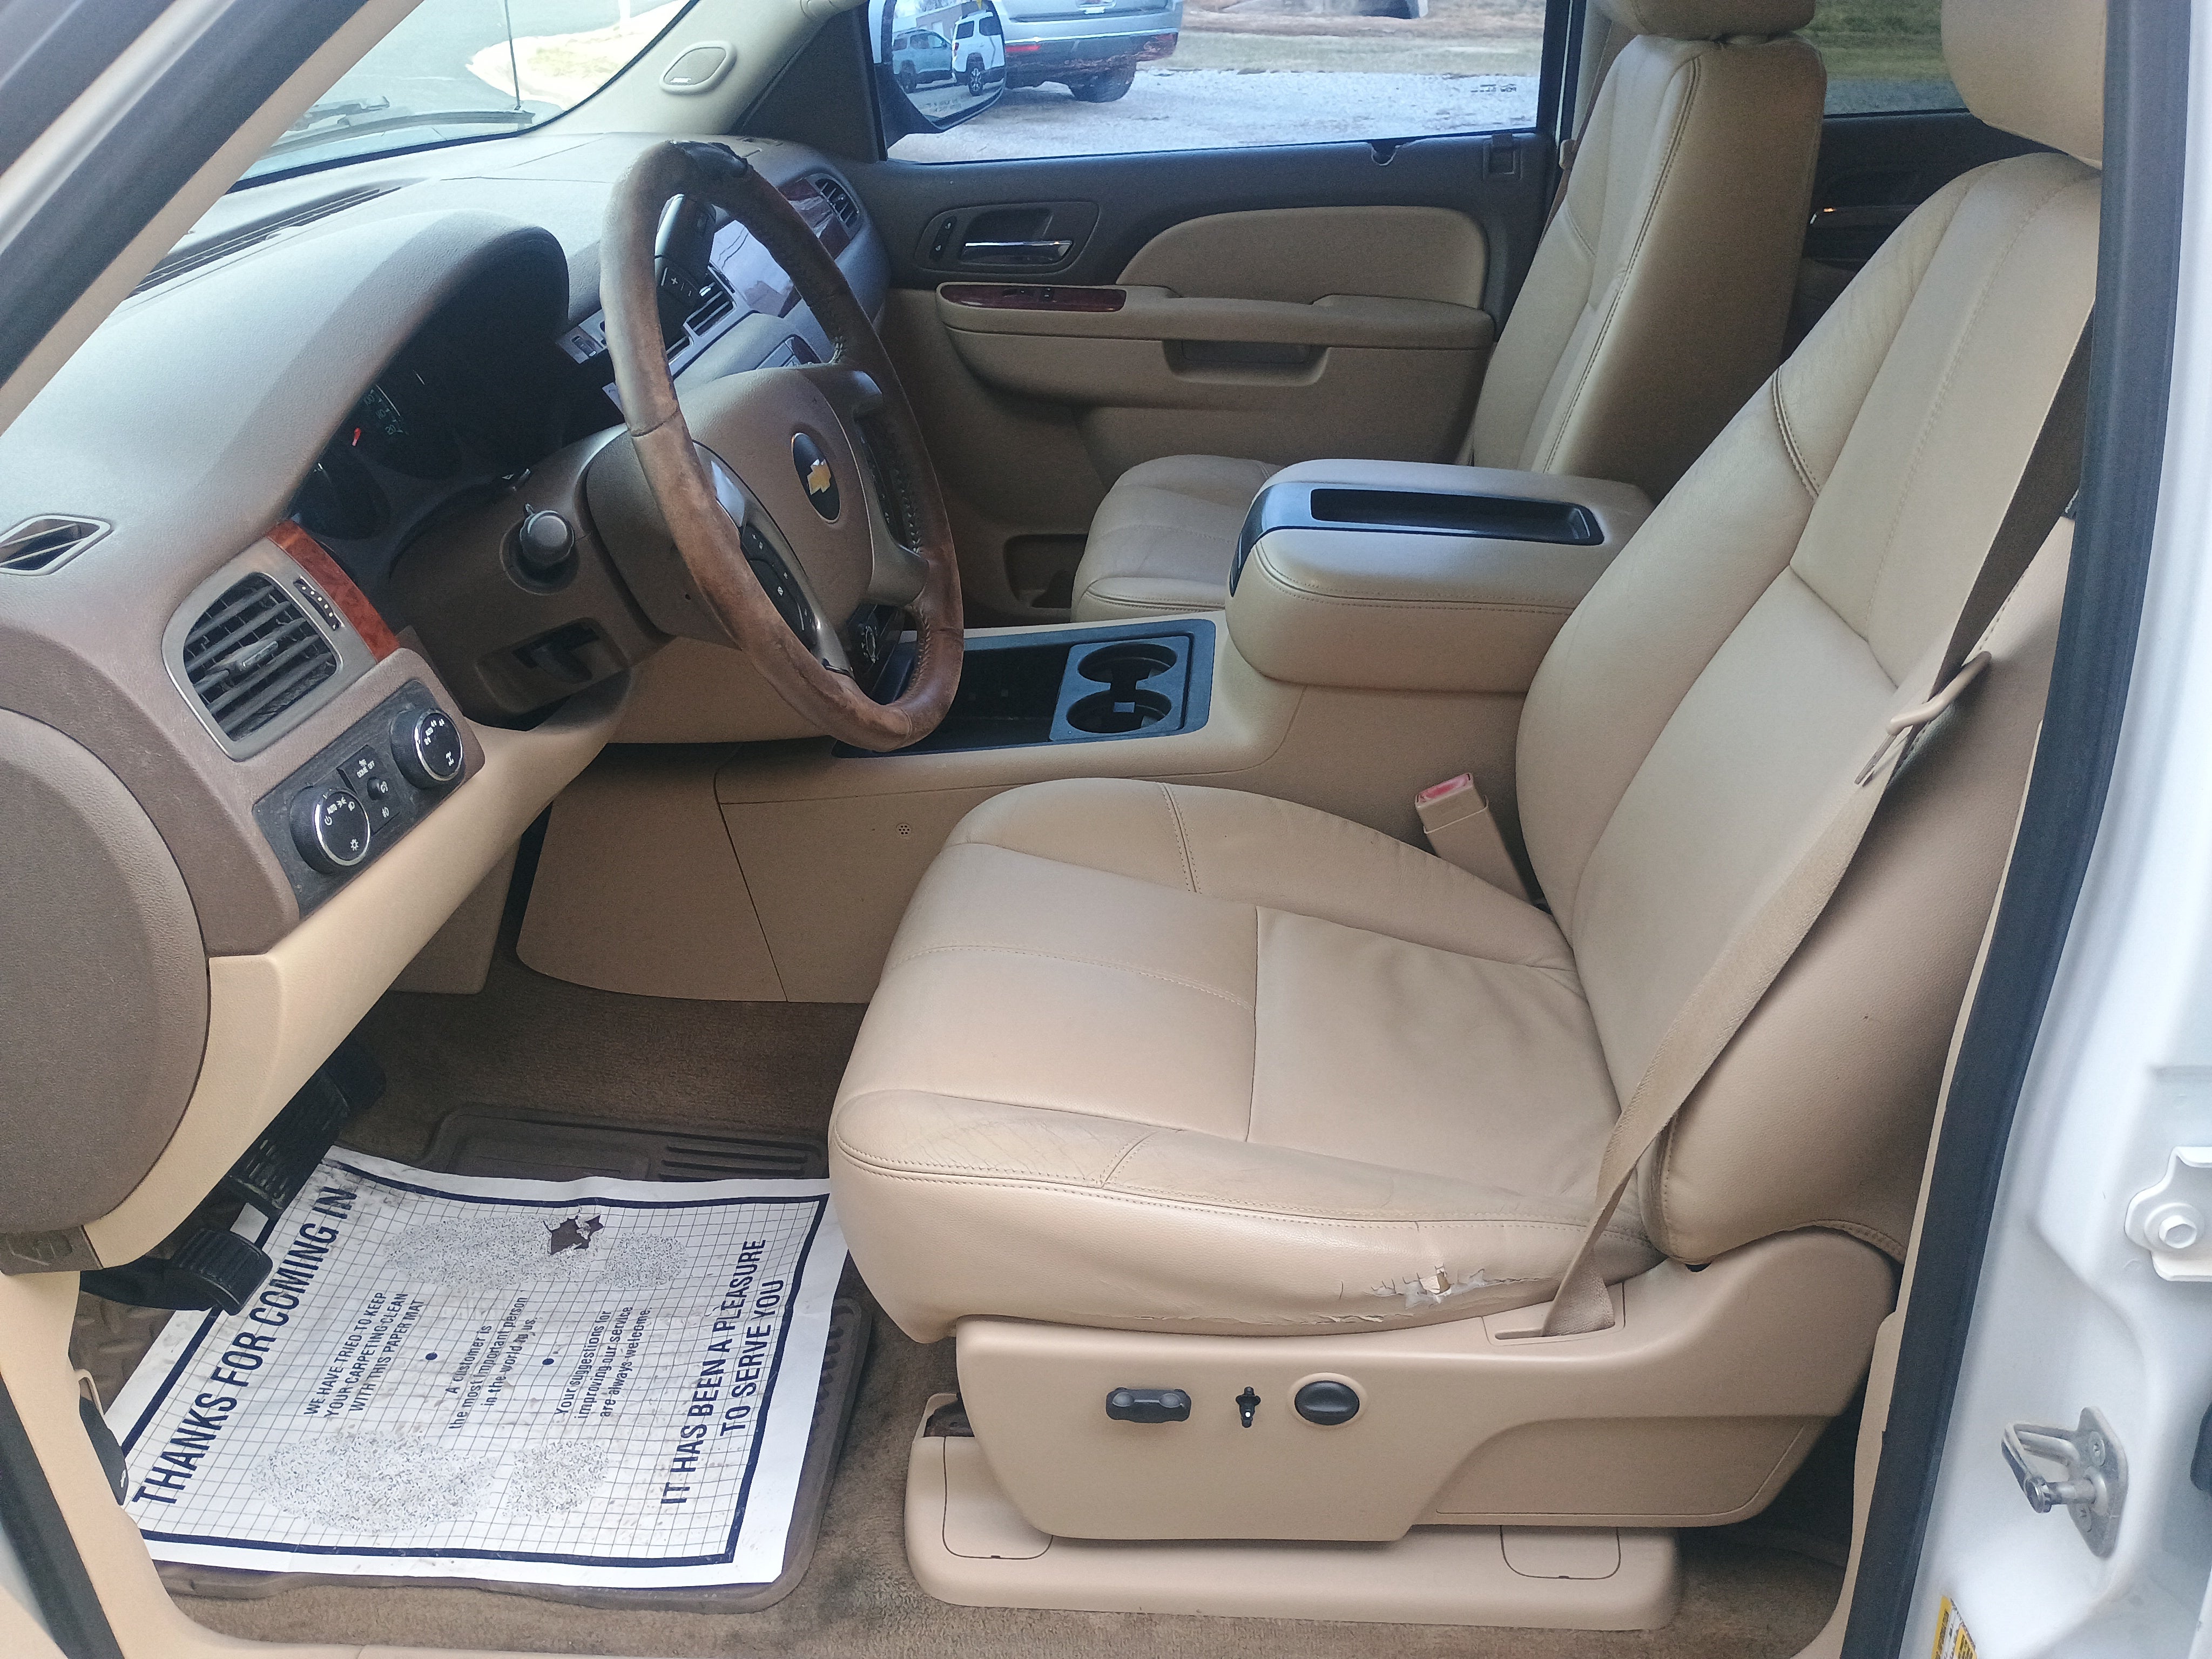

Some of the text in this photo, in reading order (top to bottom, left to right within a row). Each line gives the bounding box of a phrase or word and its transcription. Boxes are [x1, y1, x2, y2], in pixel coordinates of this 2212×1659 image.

[132, 1186, 358, 1504] THANKS FOR COMING IN
[304, 1292, 387, 1415] WE HAVE TRIED TO KEEP
[324, 1293, 409, 1418] YOUR CARPETING CLEAN
[349, 1299, 424, 1411] WITH THIS PAPER MAT
[448, 1297, 528, 1429] the most important person
[453, 1337, 485, 1382] customer
[476, 1325, 492, 1334] is
[488, 1376, 507, 1393] the
[500, 1345, 522, 1373] world
[513, 1333, 529, 1343] to
[554, 1311, 612, 1414] Your suggestions for
[574, 1306, 633, 1419] improving our service
[599, 1398, 616, 1417] are
[608, 1361, 633, 1395] always
[660, 1239, 766, 1505] IT HAS BEEN A PLEASURE
[720, 1280, 785, 1437] TO SERVE YOU
[481, 1397, 498, 1406] in
